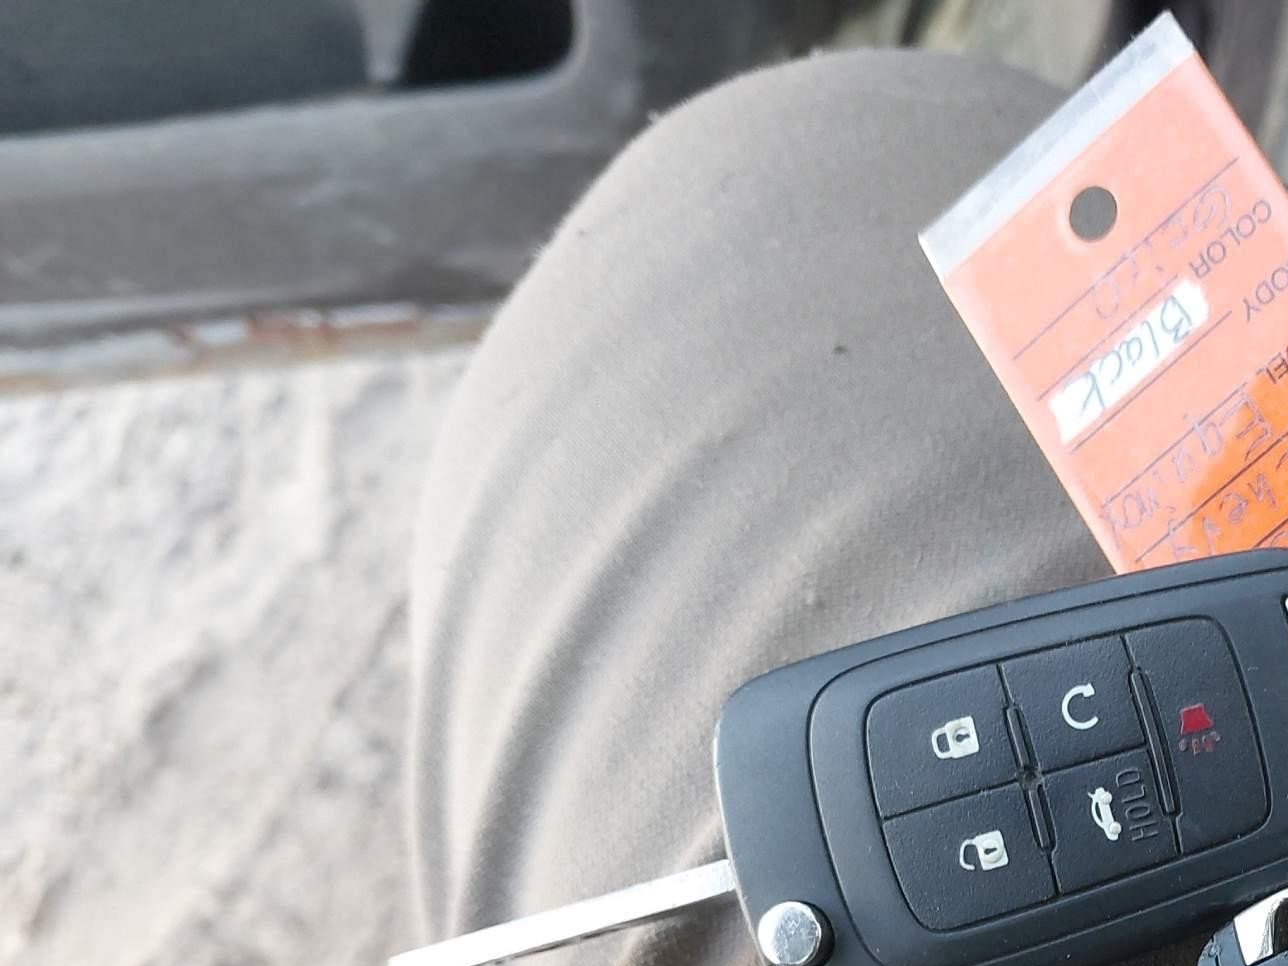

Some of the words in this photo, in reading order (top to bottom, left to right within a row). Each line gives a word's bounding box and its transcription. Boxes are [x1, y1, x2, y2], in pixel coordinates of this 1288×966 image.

[1189, 200, 1272, 279] COLOR
[1080, 295, 1193, 418] Black
[1115, 767, 1159, 841] HOLD
